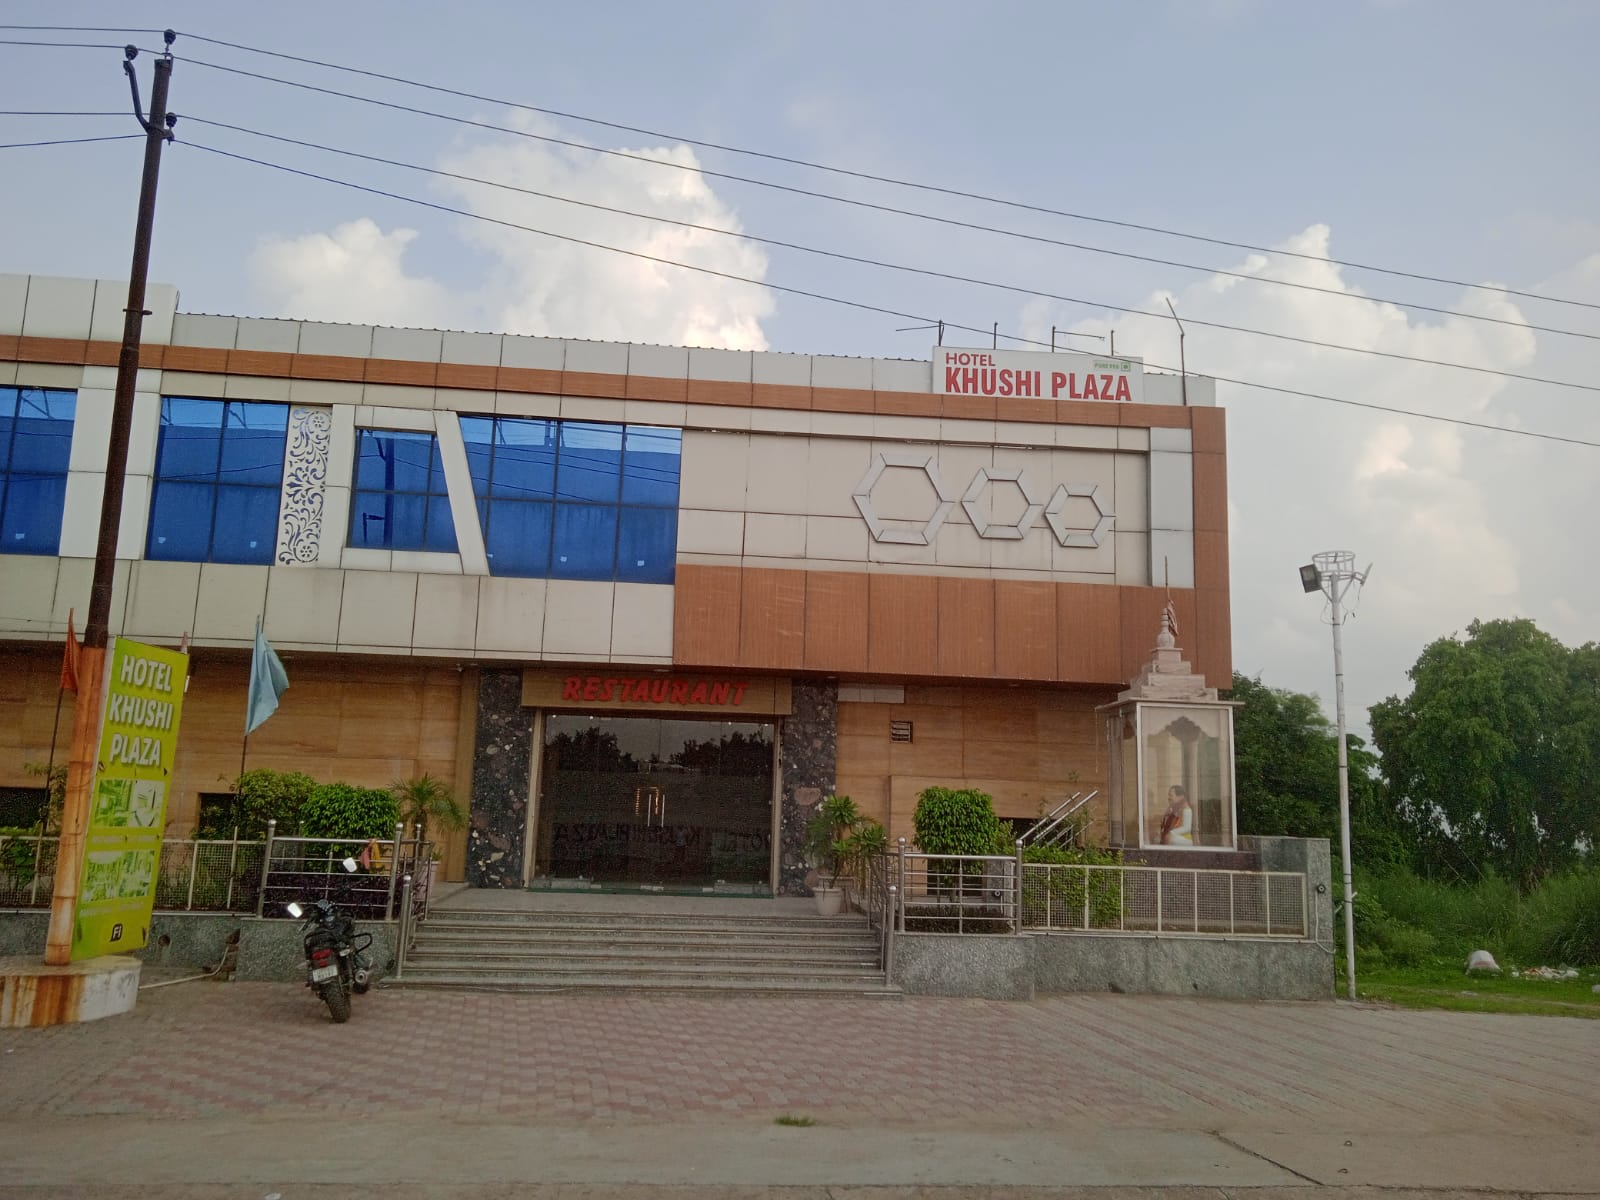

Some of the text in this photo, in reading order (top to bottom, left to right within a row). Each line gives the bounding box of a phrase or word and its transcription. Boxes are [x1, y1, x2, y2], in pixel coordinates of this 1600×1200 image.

[945, 352, 996, 366] HOTEL
[945, 367, 1132, 400] KHUSHI PLAZA
[121, 655, 171, 691] HOTEL
[563, 676, 748, 704] RESTAURANT
[109, 694, 172, 729] KHUSHI
[109, 734, 160, 766] PLAZA
